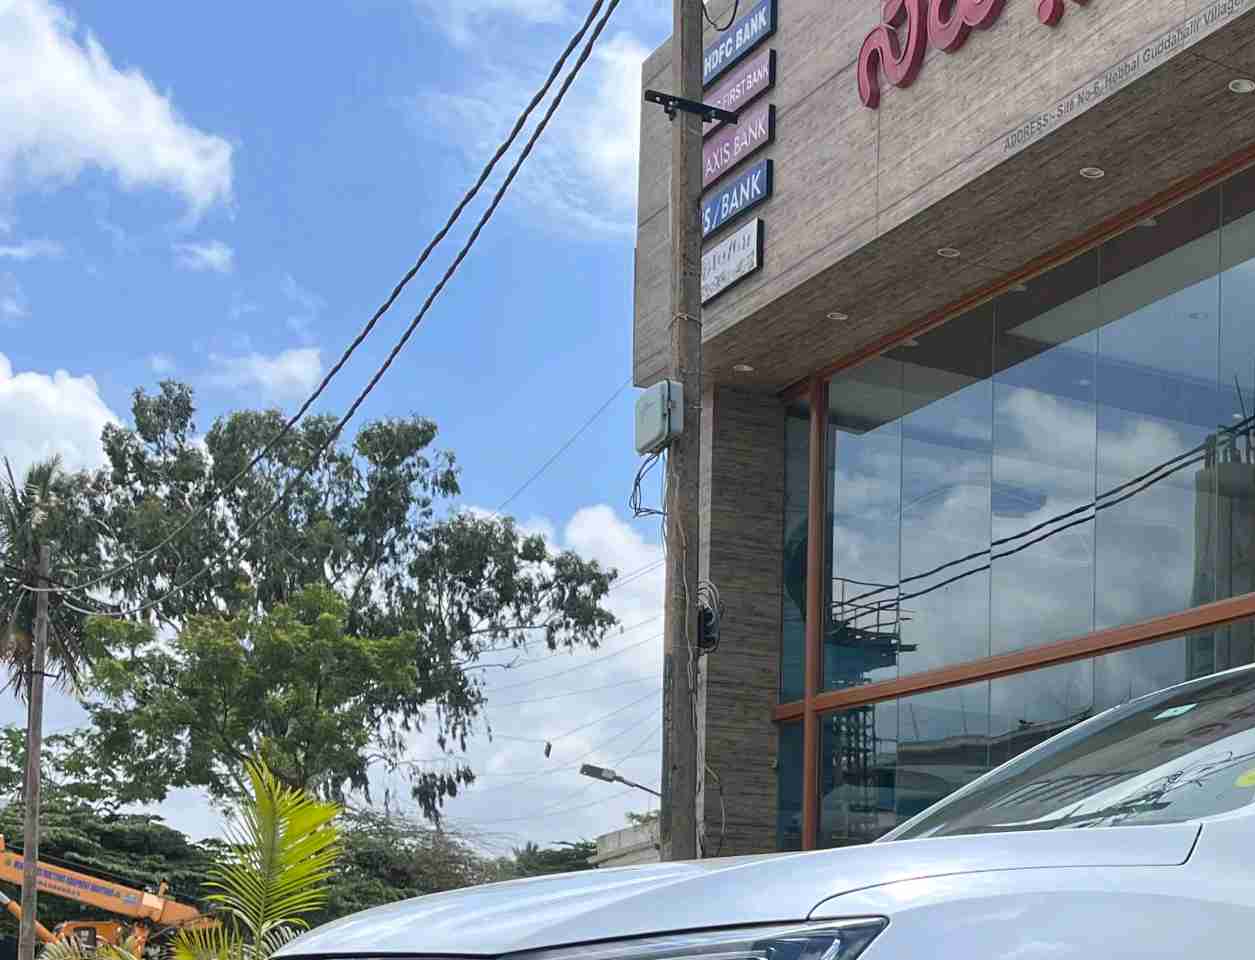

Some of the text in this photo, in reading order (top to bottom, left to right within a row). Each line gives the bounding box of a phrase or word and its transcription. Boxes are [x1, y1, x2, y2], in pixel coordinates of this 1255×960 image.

[704, 6, 767, 75] HDFC BANK
[705, 113, 766, 177] AXIS BANK
[721, 169, 761, 219] BANK
